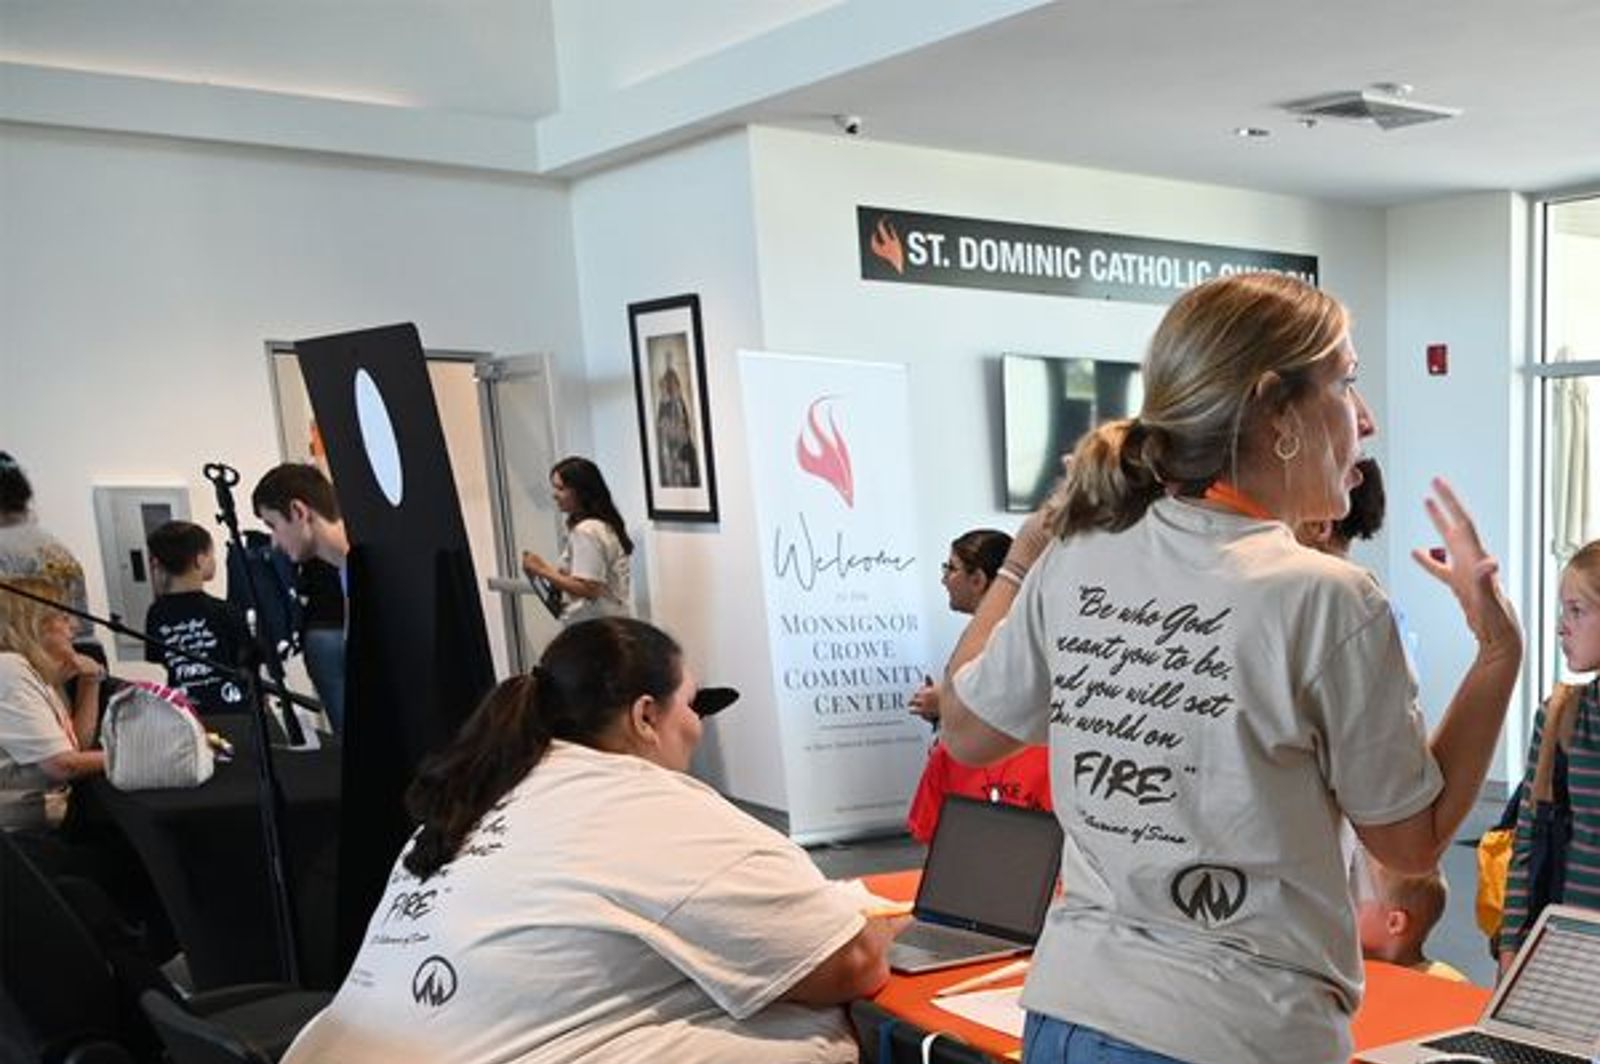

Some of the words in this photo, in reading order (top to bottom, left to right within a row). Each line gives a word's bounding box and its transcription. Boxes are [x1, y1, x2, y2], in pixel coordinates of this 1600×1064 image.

[907, 231, 950, 267] ST.
[959, 236, 1080, 279] DOMINIC
[1090, 249, 1211, 289] CATHOLIC
[774, 511, 915, 592] Welcome
[780, 613, 918, 635] MONSIGNOR
[1117, 598, 1163, 626] who
[1155, 603, 1231, 645] God
[812, 640, 897, 661] CROWE
[1110, 646, 1160, 676] you
[1162, 644, 1195, 670] to
[783, 666, 925, 691] COMMUNITY
[1053, 664, 1089, 691] nd
[1075, 679, 1122, 708] you
[1125, 681, 1185, 710] will
[1183, 693, 1235, 718] set
[814, 692, 905, 716] CENTER
[1076, 713, 1149, 743] world
[1143, 729, 1184, 749] on
